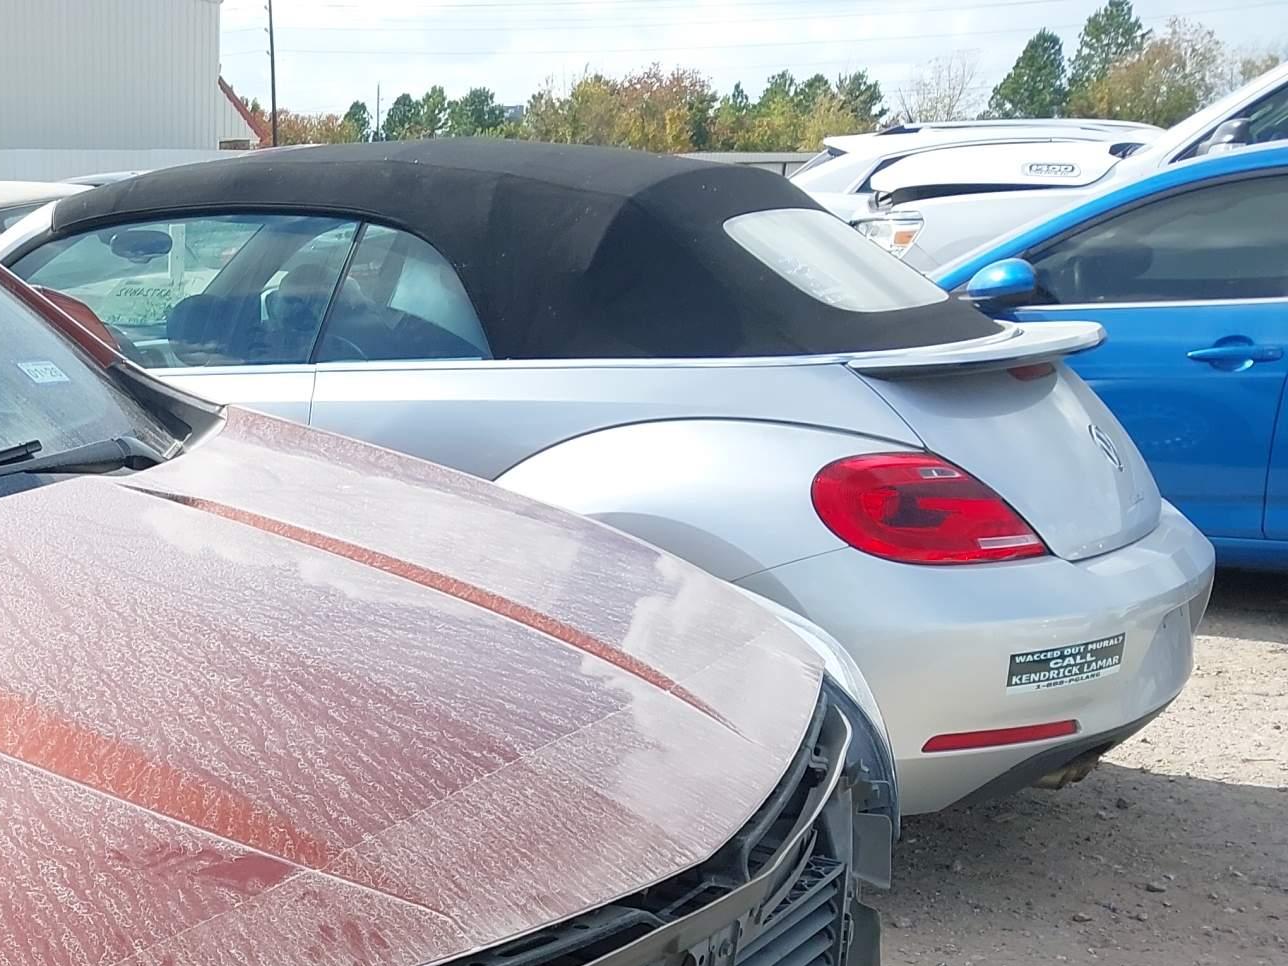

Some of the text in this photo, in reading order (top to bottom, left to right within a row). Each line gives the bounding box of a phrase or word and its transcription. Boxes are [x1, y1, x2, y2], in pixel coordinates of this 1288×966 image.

[1015, 650, 1061, 664] WACCED
[1063, 646, 1086, 656] OUT
[1049, 652, 1097, 669] CALL
[1011, 656, 1120, 686] KENDRICK LAMAR
